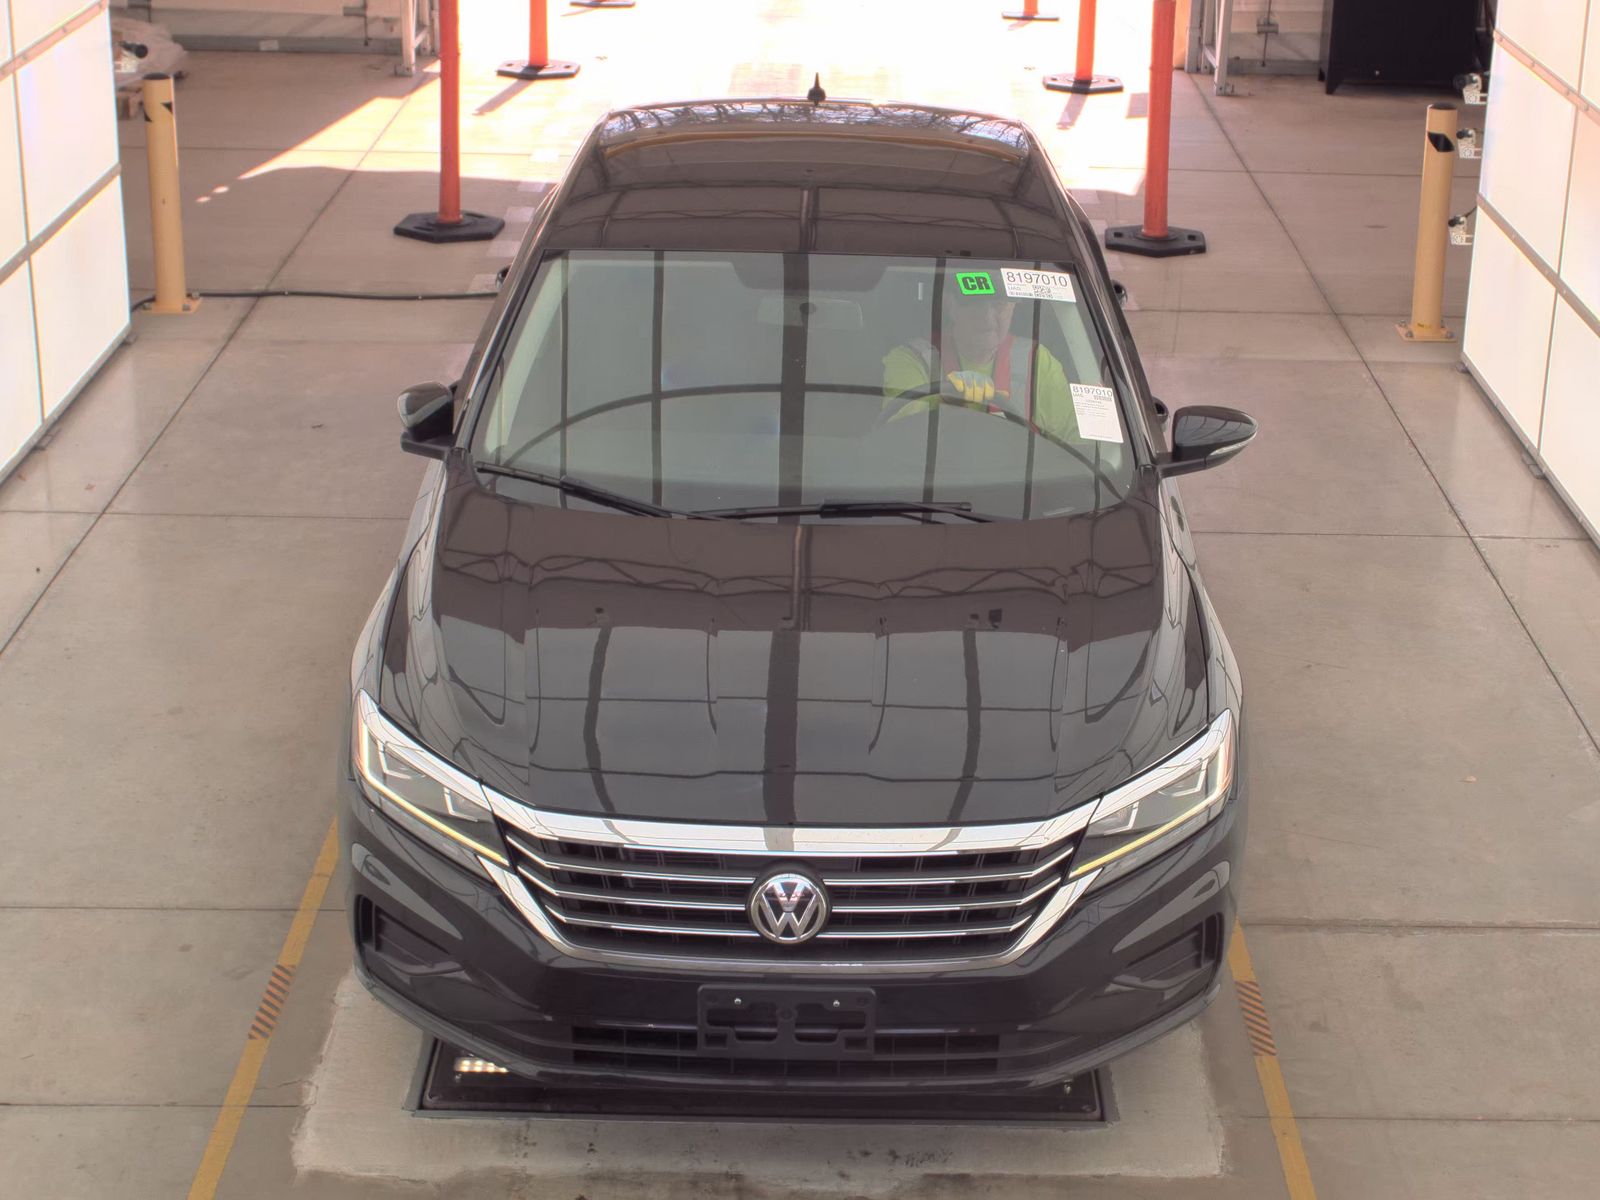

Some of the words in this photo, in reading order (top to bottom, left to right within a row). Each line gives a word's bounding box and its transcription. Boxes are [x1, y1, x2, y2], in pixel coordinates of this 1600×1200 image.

[962, 276, 991, 291] CR
[1006, 271, 1067, 287] 8197010
[1072, 386, 1112, 397] 8197010
[756, 875, 821, 942] VW
